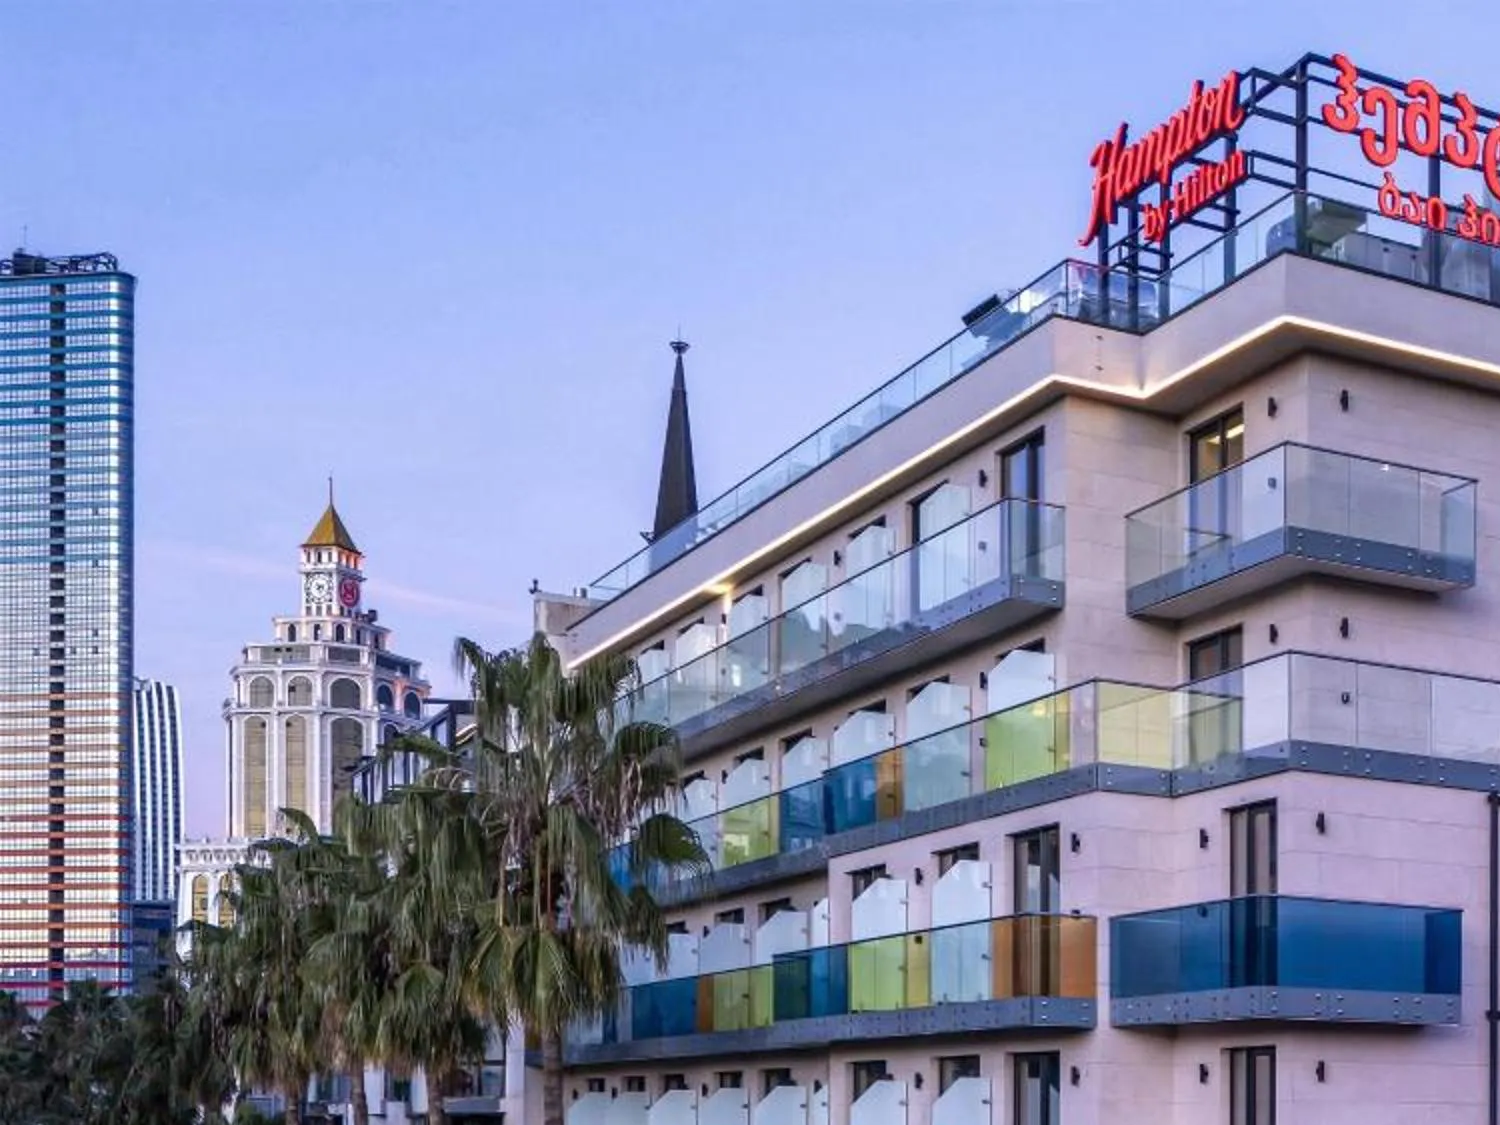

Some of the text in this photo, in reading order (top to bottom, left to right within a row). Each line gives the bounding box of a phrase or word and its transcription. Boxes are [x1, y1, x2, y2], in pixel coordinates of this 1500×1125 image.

[1078, 70, 1244, 247] Hampton
[1143, 149, 1247, 243] by Hilton
[1378, 171, 1447, 232] ბაი
